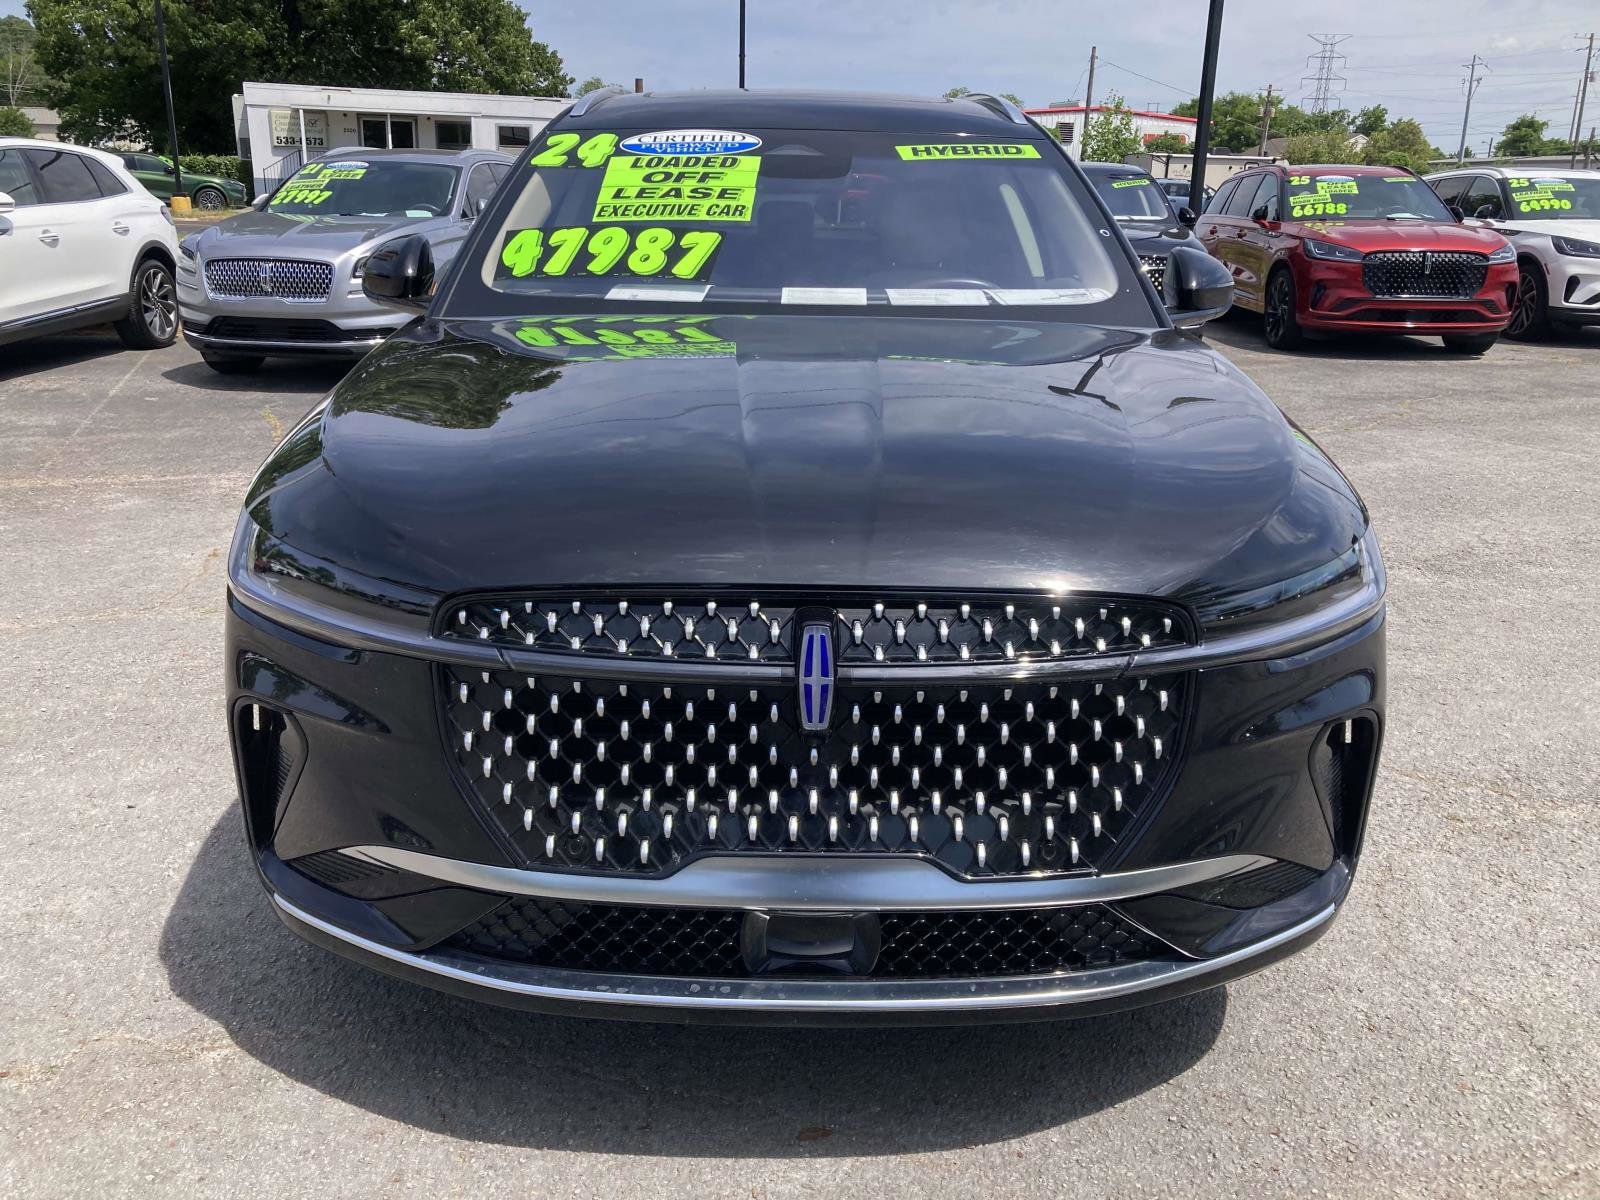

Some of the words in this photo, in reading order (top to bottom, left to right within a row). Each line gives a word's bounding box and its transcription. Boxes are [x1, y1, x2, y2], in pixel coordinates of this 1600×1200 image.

[638, 134, 746, 143] CERTIFIED
[531, 133, 619, 168] 24
[641, 142, 741, 150] PRE-OWNED
[911, 145, 1025, 157] HYBRID
[630, 156, 742, 169] LOADED
[642, 171, 727, 184] OFF
[1289, 175, 1310, 185] 25
[1508, 178, 1530, 187] 25
[611, 186, 743, 201] LEASE
[596, 203, 702, 218] EXECUTIVE
[706, 203, 748, 217] CAR
[1292, 203, 1348, 218] 66788
[502, 227, 722, 279] 47987
